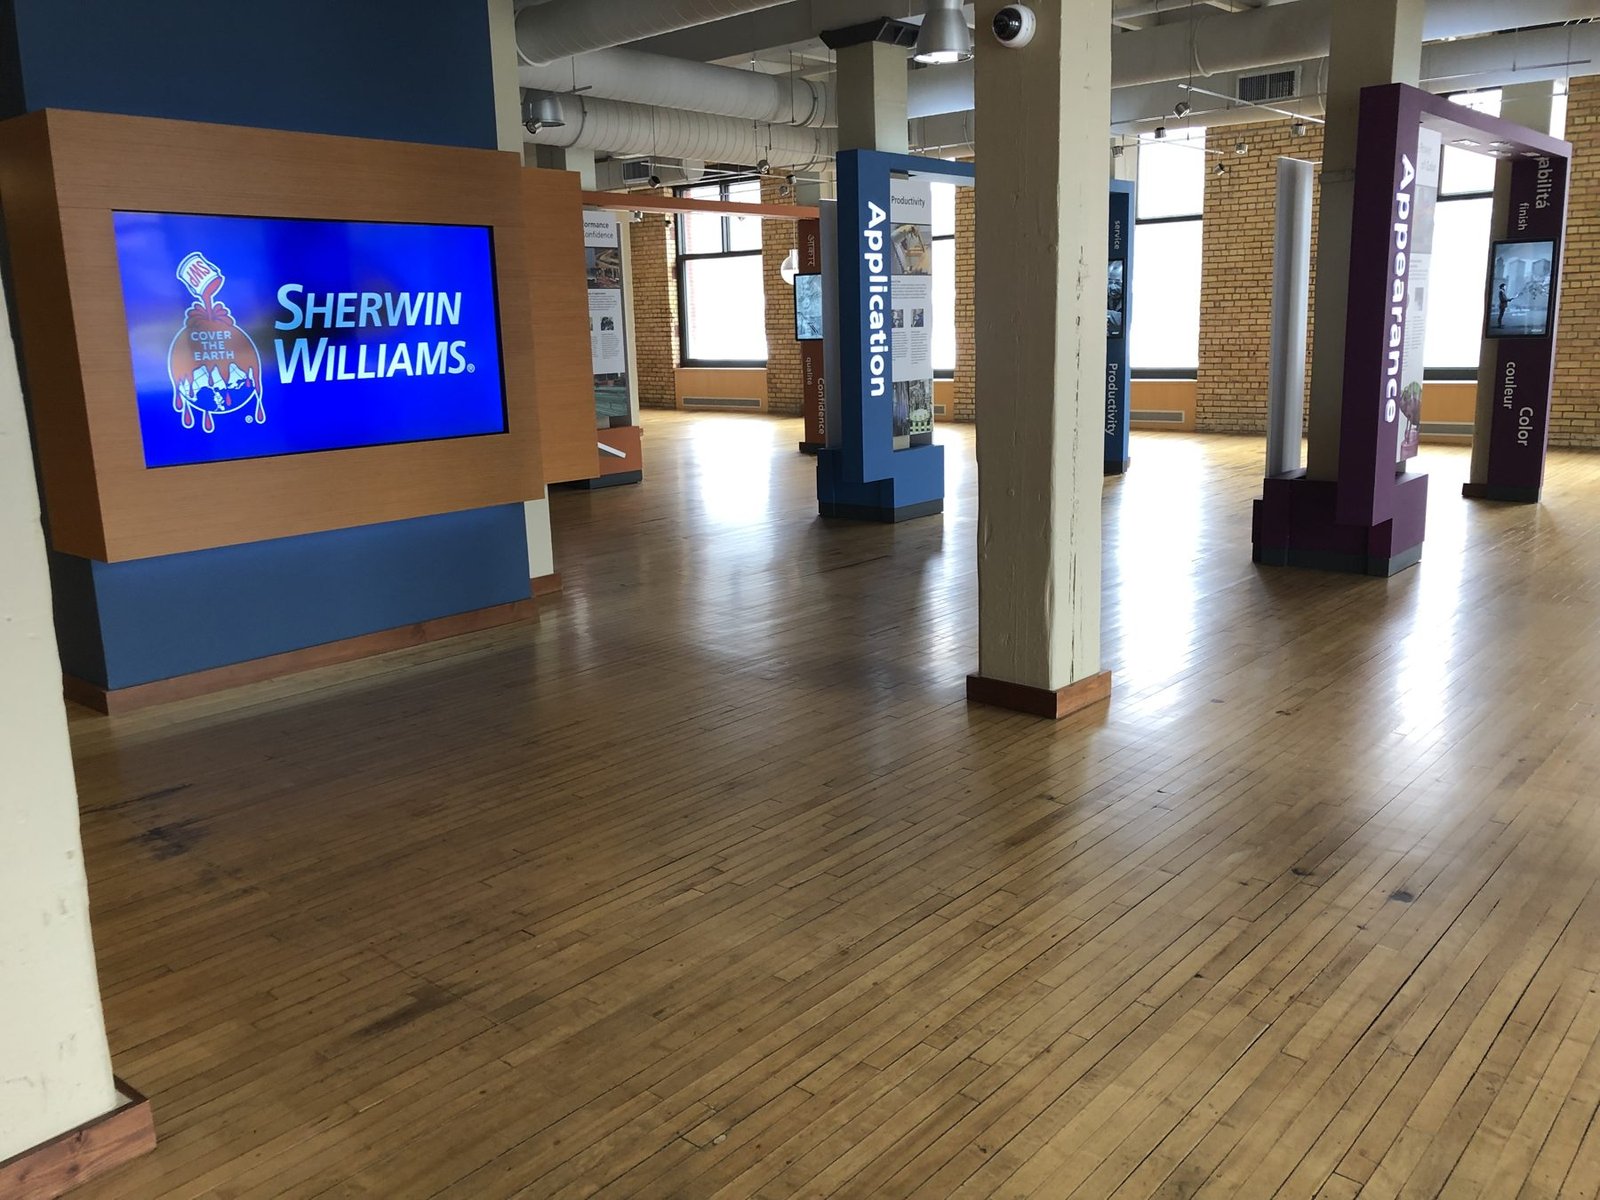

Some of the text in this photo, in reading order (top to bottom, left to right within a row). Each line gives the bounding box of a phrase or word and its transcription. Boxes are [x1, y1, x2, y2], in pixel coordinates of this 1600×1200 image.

[891, 195, 926, 208] Productivity
[1517, 202, 1530, 231] finish
[1113, 220, 1122, 250] service
[186, 260, 211, 288] SWP
[1384, 154, 1416, 422] Appearance
[274, 283, 462, 331] SHERWIN
[863, 200, 889, 397] Application
[190, 330, 232, 341] COVER
[201, 341, 225, 351] THE
[194, 351, 235, 361] EARTH
[1105, 363, 1119, 436] Productivity
[1503, 361, 1518, 410] couleur
[817, 378, 827, 435] Confidence
[1517, 406, 1534, 446] Color
